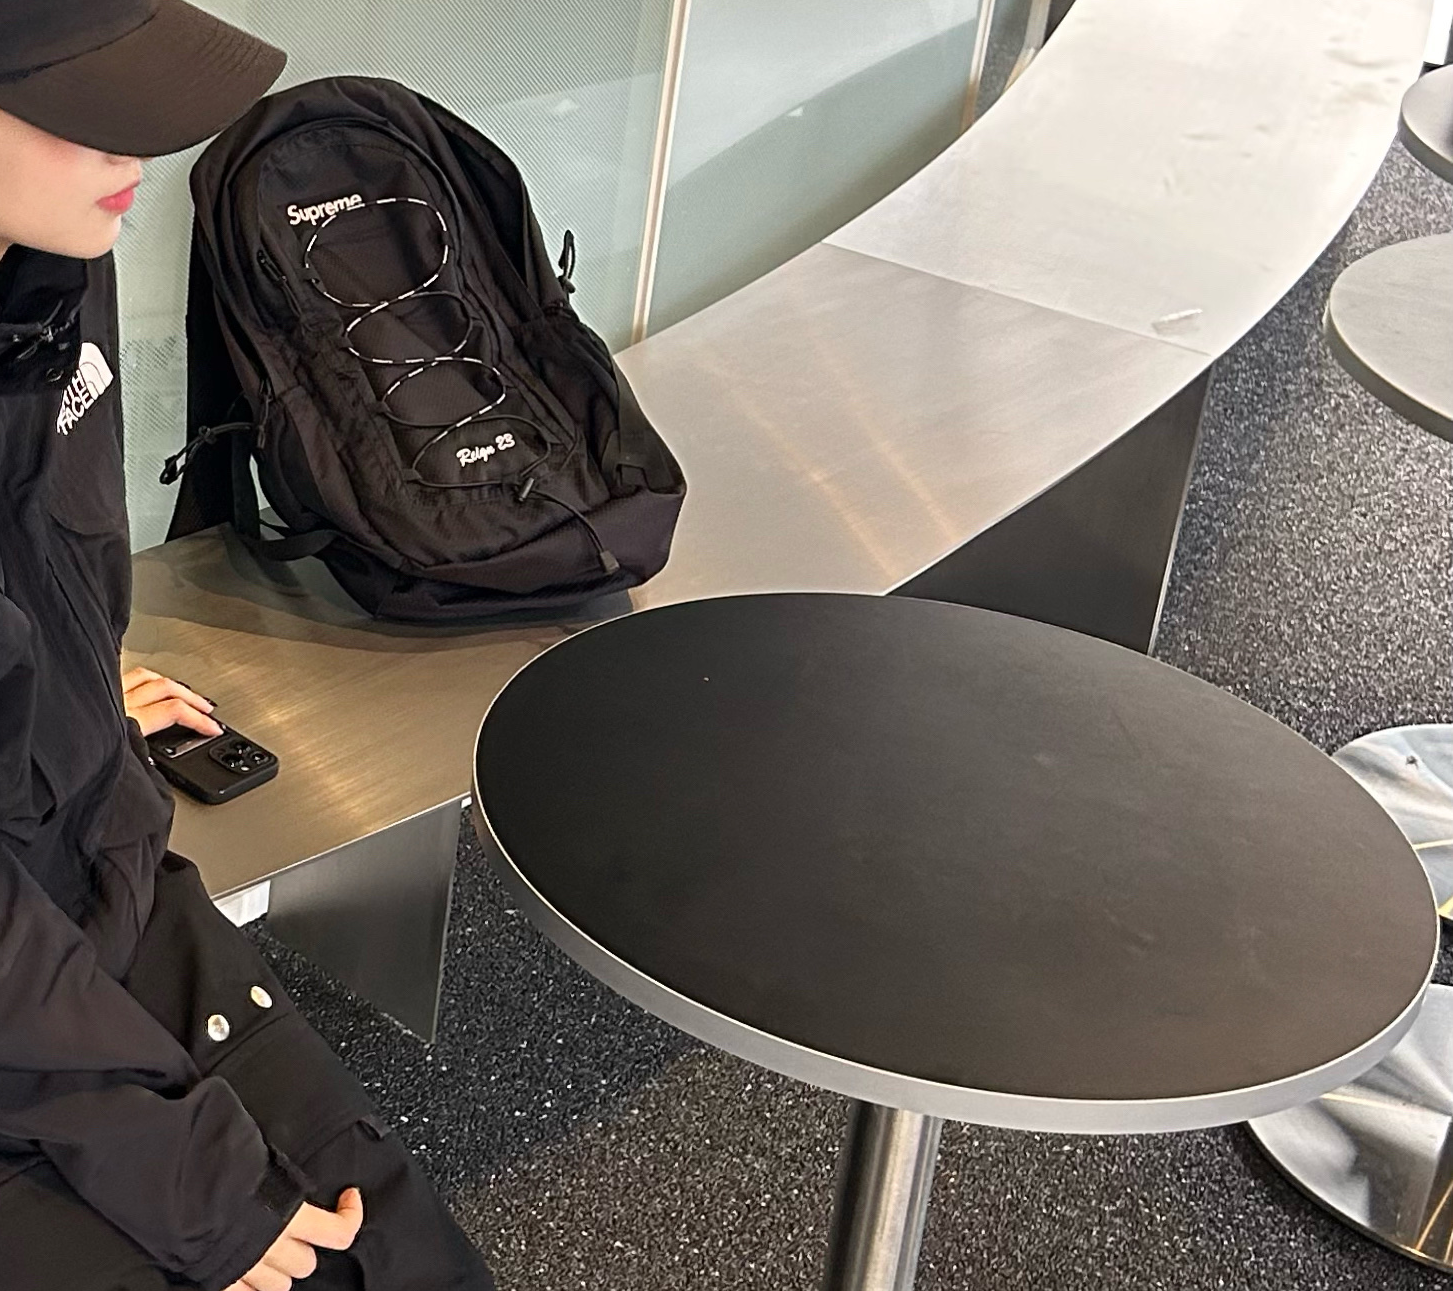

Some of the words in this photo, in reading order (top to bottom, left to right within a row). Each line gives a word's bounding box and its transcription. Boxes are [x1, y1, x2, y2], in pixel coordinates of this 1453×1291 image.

[287, 194, 362, 225] Supreme
[57, 392, 94, 436] FACE
[495, 433, 515, 450] 23
